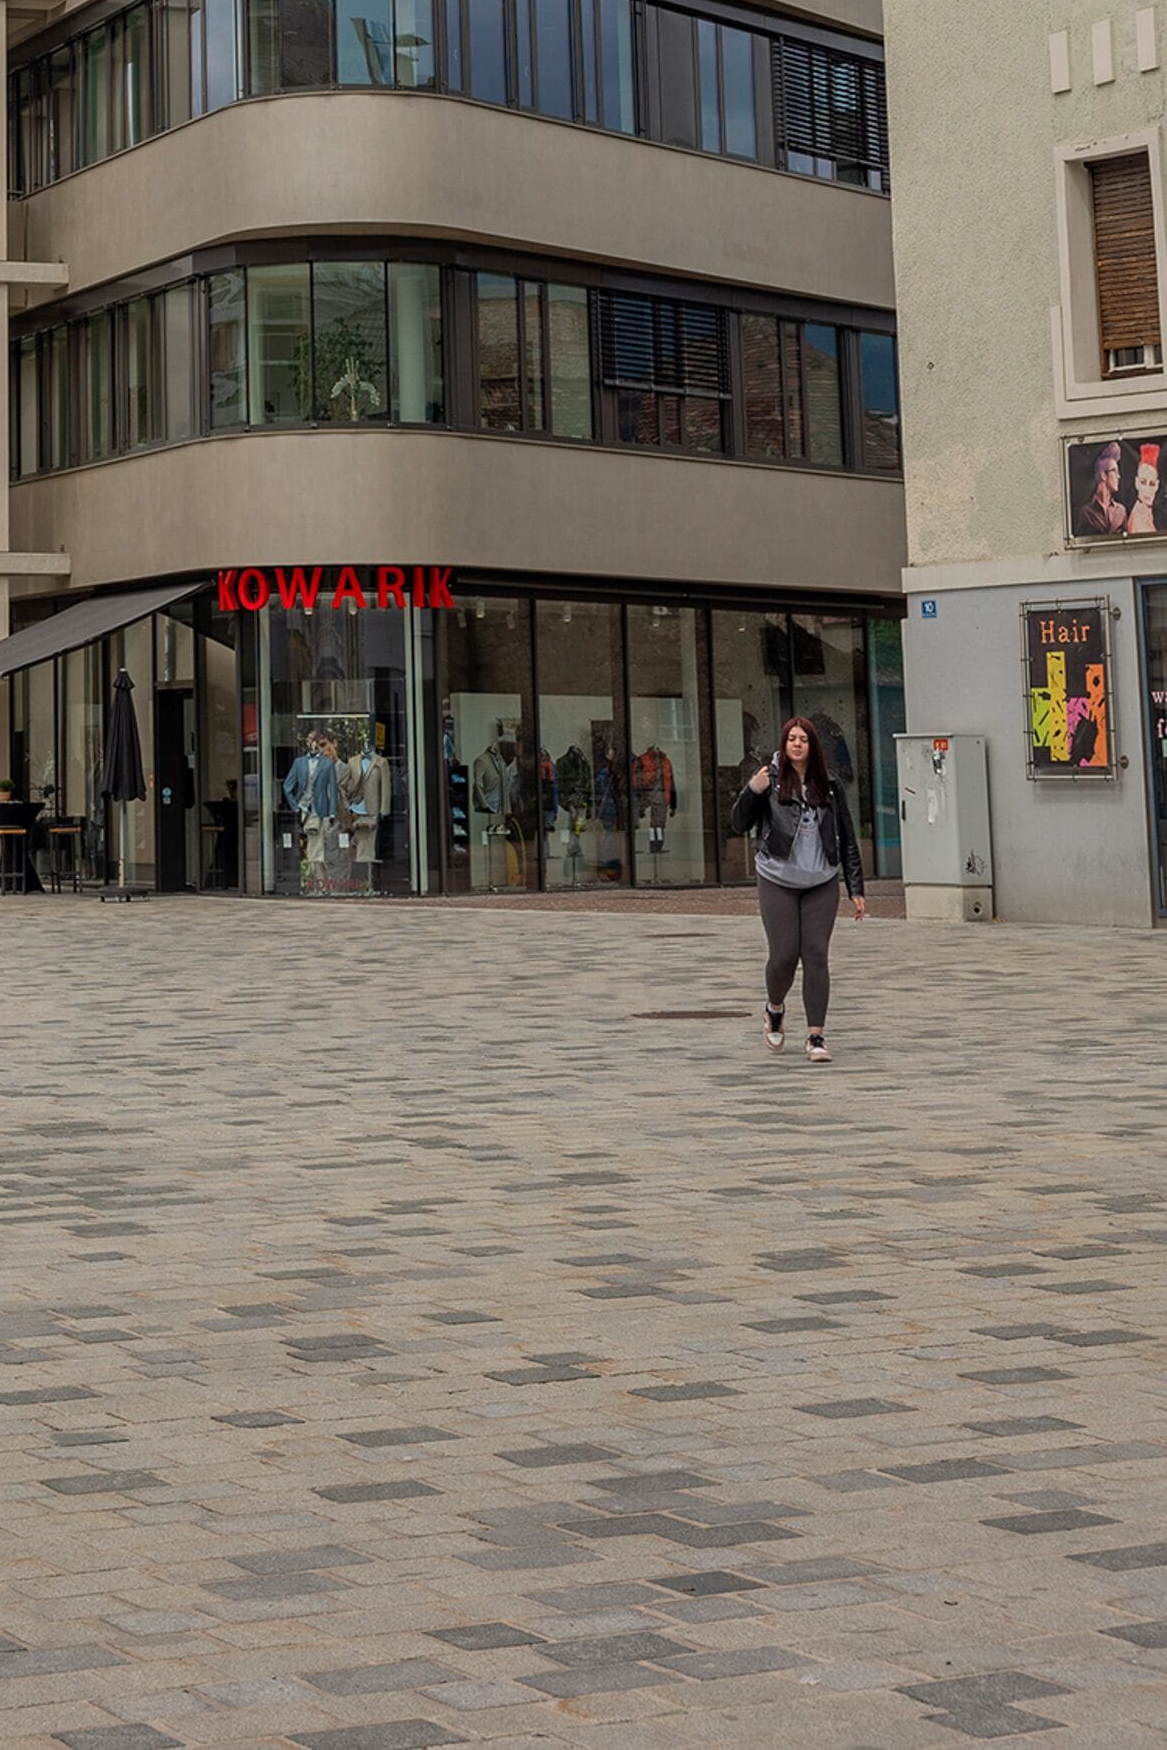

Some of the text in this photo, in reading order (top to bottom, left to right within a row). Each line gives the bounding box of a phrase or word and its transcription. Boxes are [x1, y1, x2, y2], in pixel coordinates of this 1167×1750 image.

[218, 566, 455, 611] KOWARIK
[924, 601, 934, 613] 10
[1040, 619, 1090, 643] Hair
